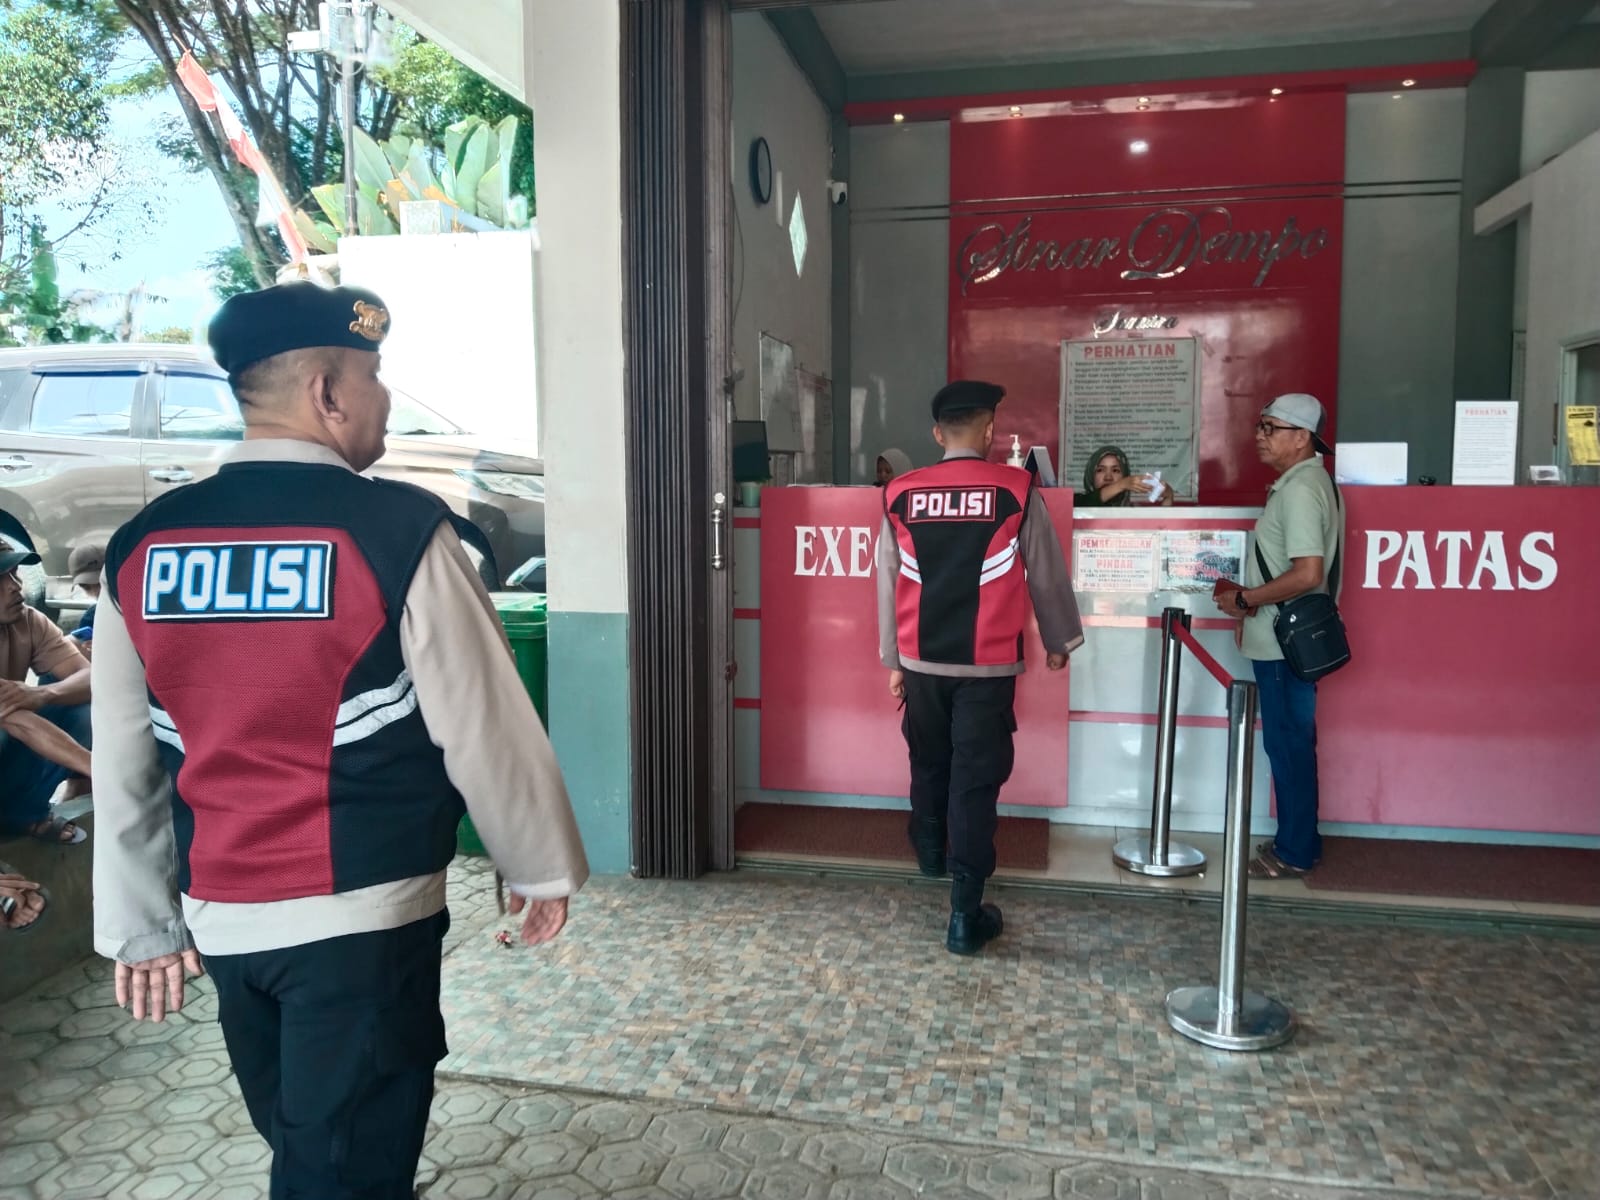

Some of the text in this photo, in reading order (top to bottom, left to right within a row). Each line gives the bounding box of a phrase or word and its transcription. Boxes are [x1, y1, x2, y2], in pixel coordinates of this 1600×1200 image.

[956, 206, 1332, 297] Sinar Dempo
[1084, 343, 1176, 358] PERHATIAN
[911, 491, 991, 518] POLISI
[147, 546, 324, 613] POLISI
[794, 525, 880, 578] EXE
[1362, 529, 1559, 591] PATAS
